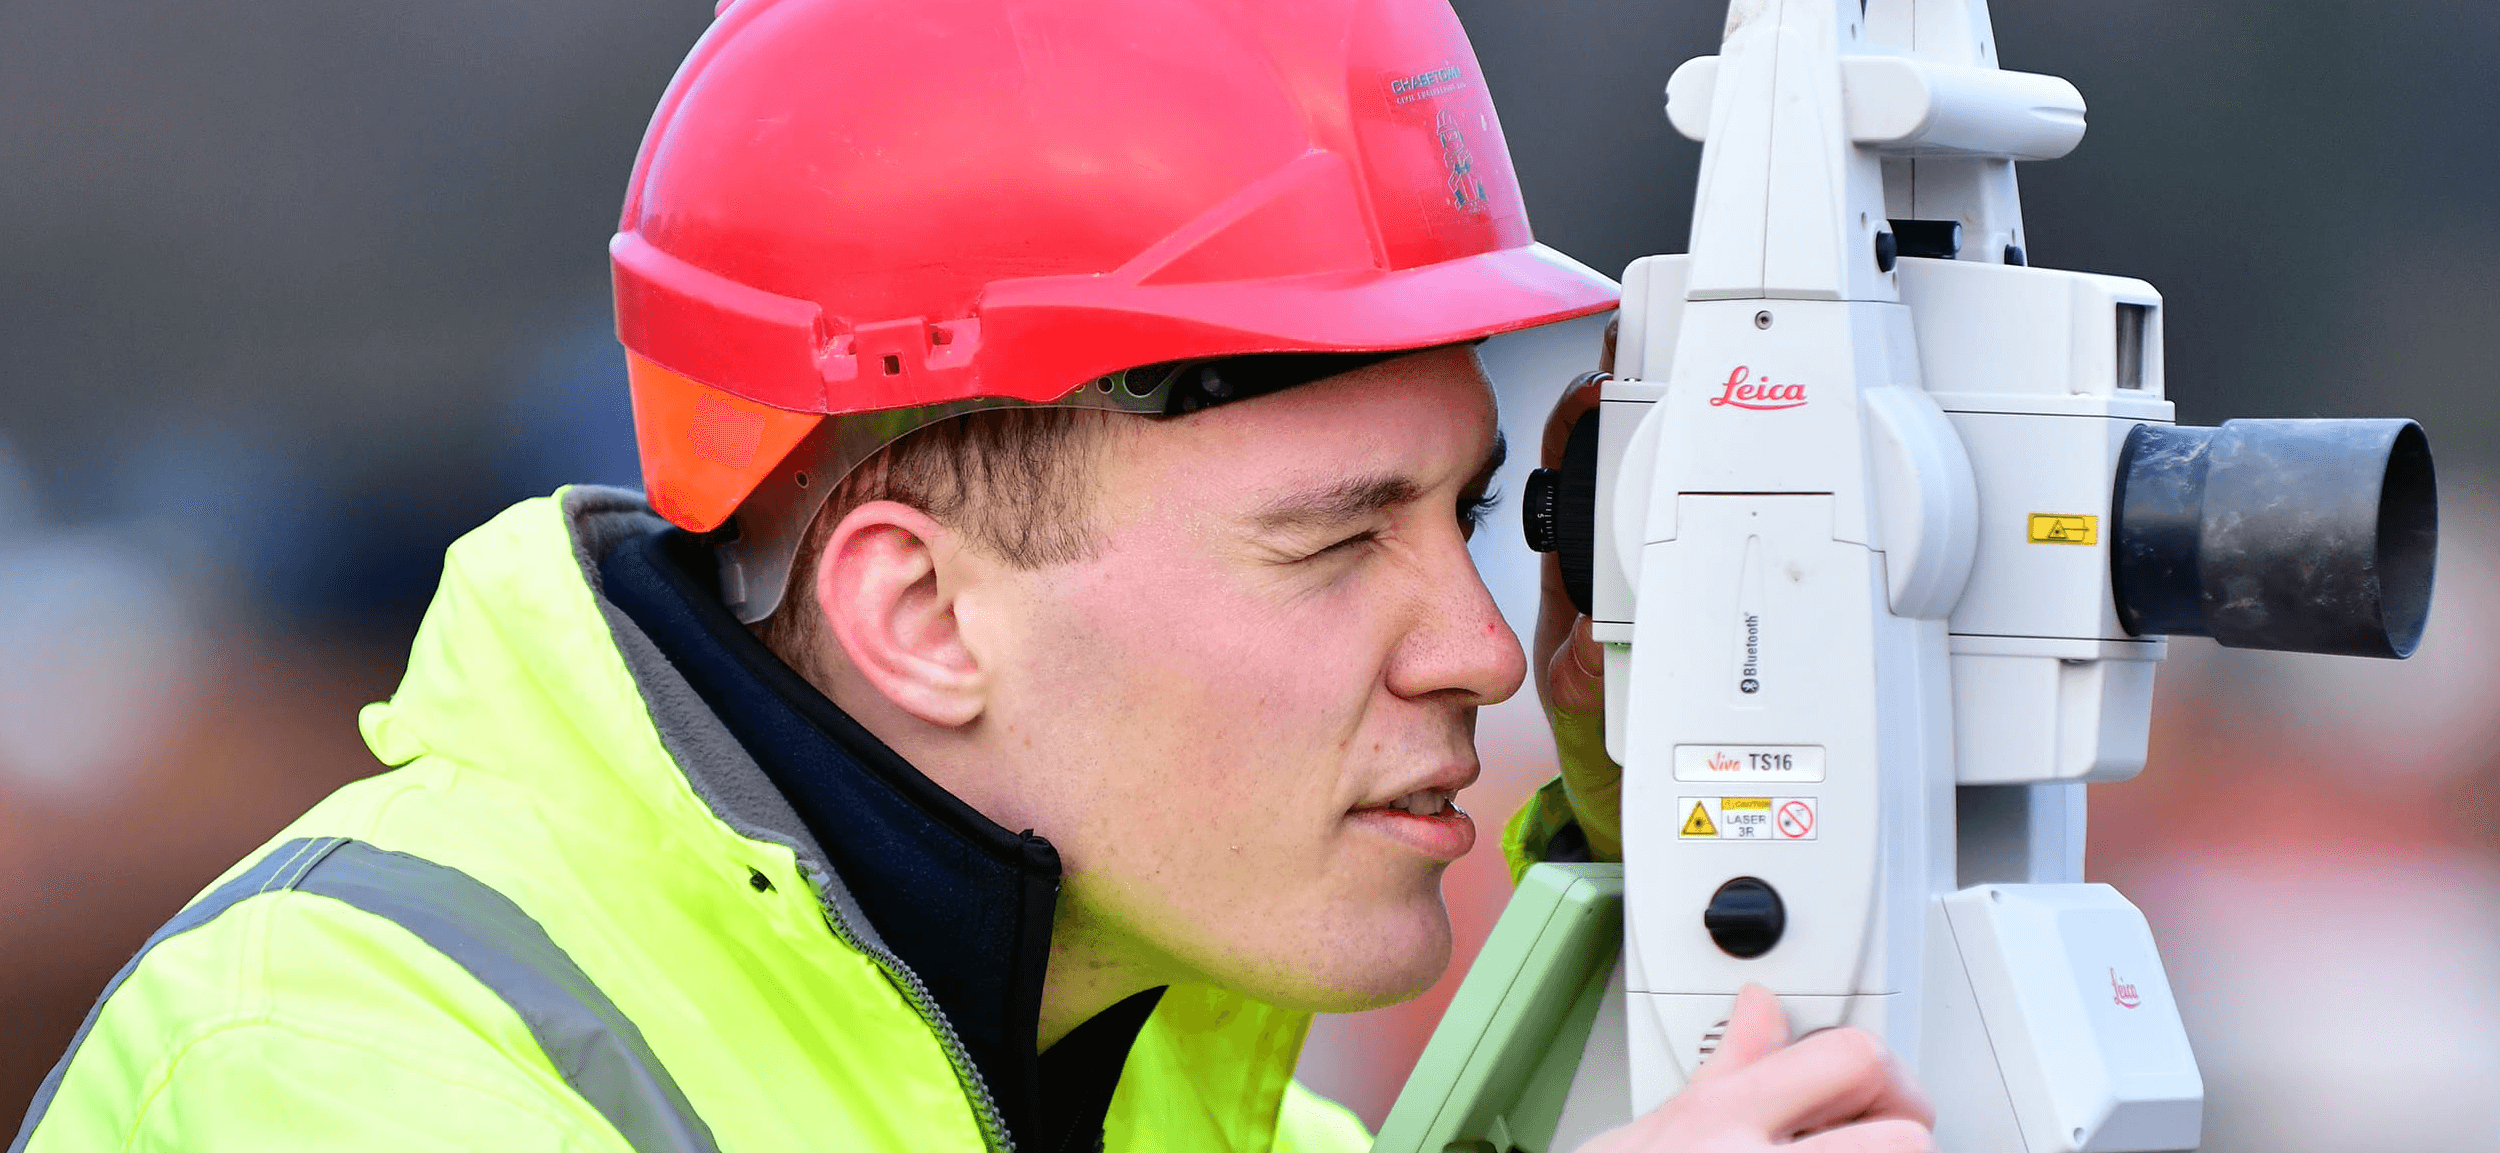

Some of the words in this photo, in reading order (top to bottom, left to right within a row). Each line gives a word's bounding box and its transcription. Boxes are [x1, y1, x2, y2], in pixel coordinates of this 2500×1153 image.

[1709, 364, 1808, 411] Leica
[1707, 750, 1740, 772] Viva
[1748, 753, 1793, 771] TS16
[1726, 814, 1767, 825] LASER
[1738, 826, 1755, 837] 3R
[2109, 966, 2141, 1009] Leica
